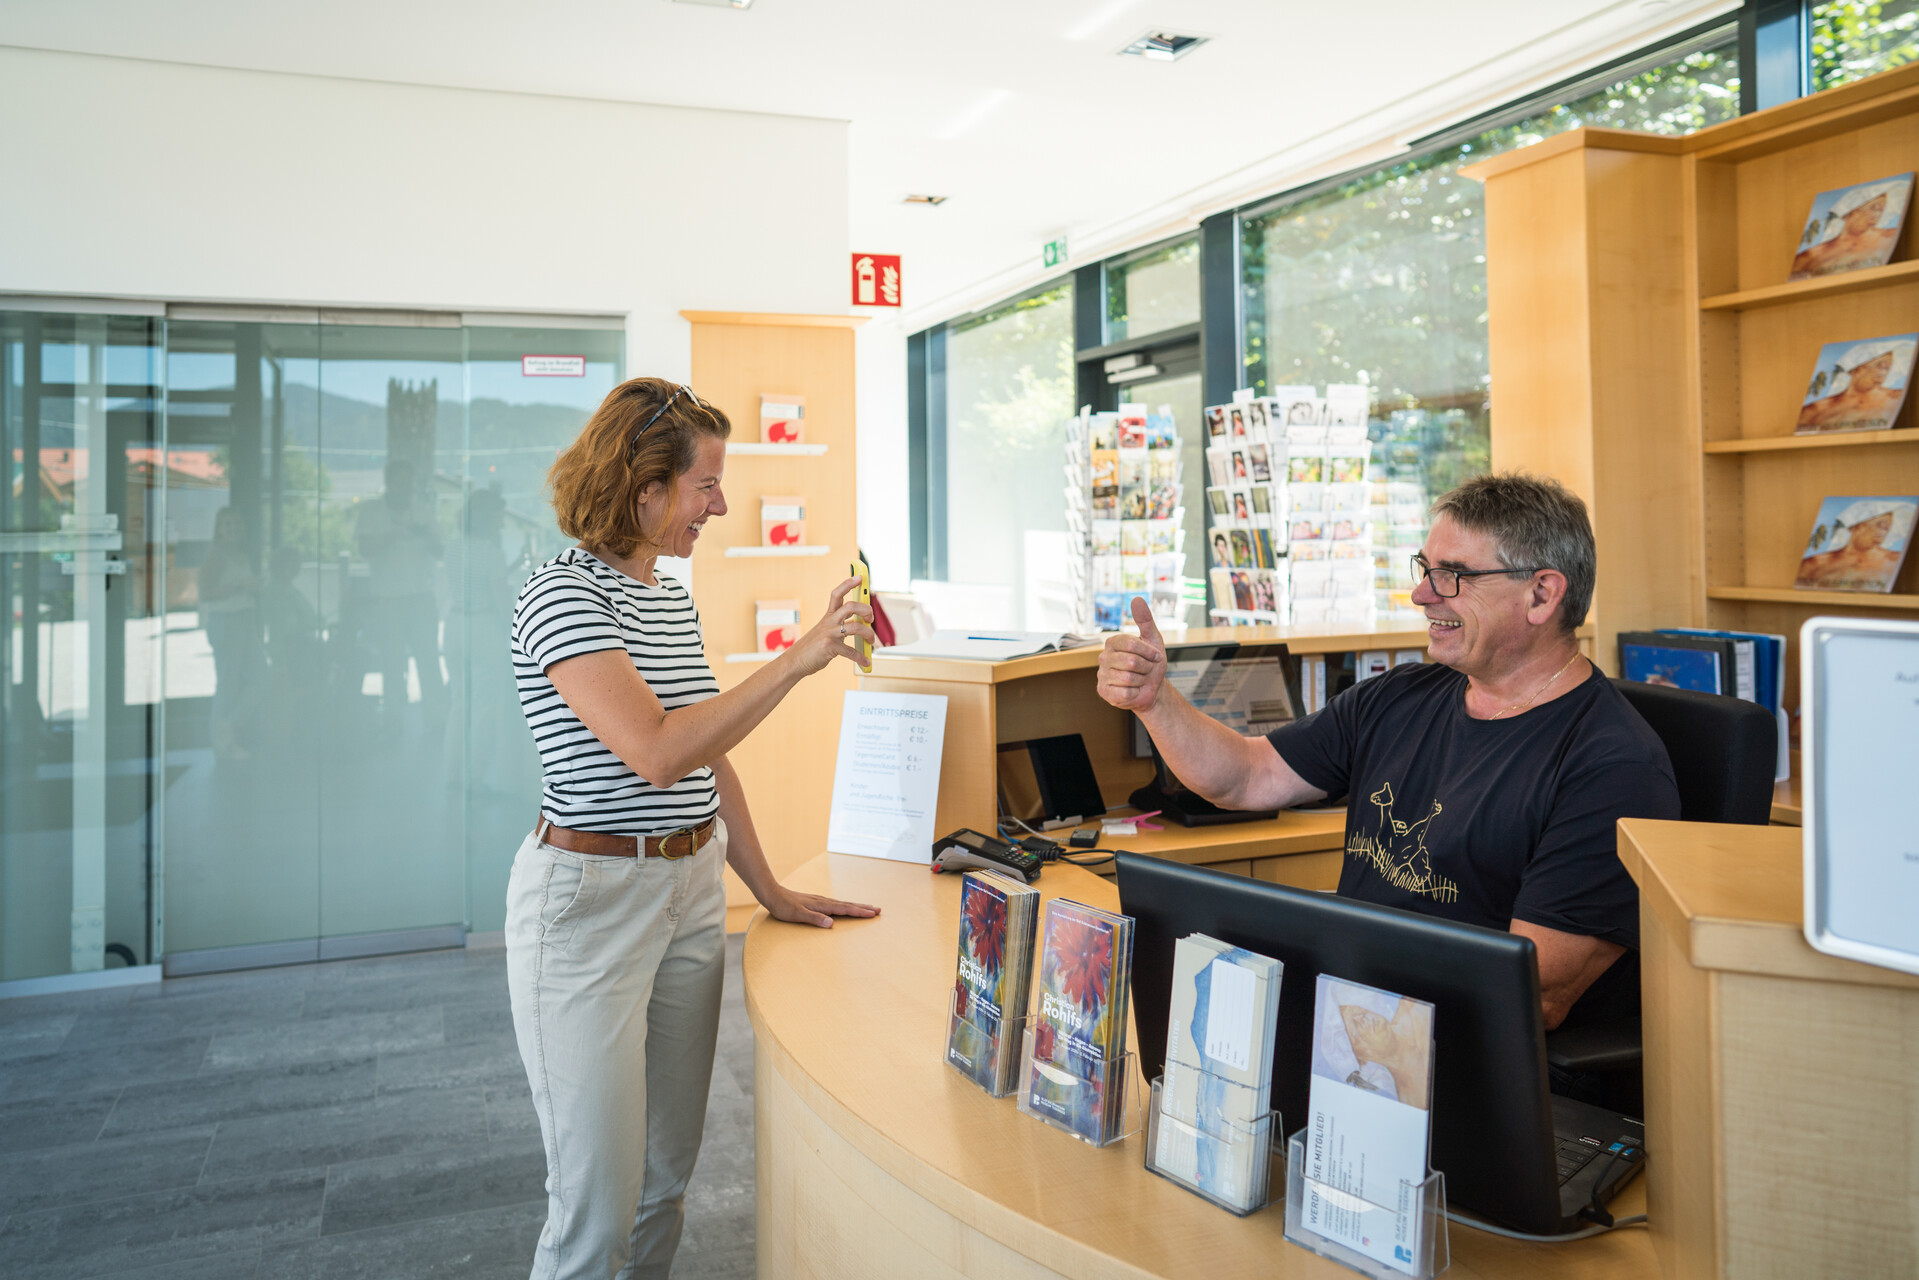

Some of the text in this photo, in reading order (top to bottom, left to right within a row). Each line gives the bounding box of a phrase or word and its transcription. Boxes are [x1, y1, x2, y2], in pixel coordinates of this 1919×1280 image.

[859, 706, 929, 720] EINTRITTSPREISE
[959, 962, 987, 990] Rohlfs
[960, 955, 982, 974] Christian
[1043, 999, 1083, 1029] Rohlfs
[1044, 992, 1075, 1012] Christian
[1169, 1019, 1181, 1072] AKTIVITÄTEN
[1164, 1073, 1175, 1115] UNSEREN
[1314, 1112, 1325, 1162] MITGLIED!
[1313, 1164, 1321, 1180] SIE
